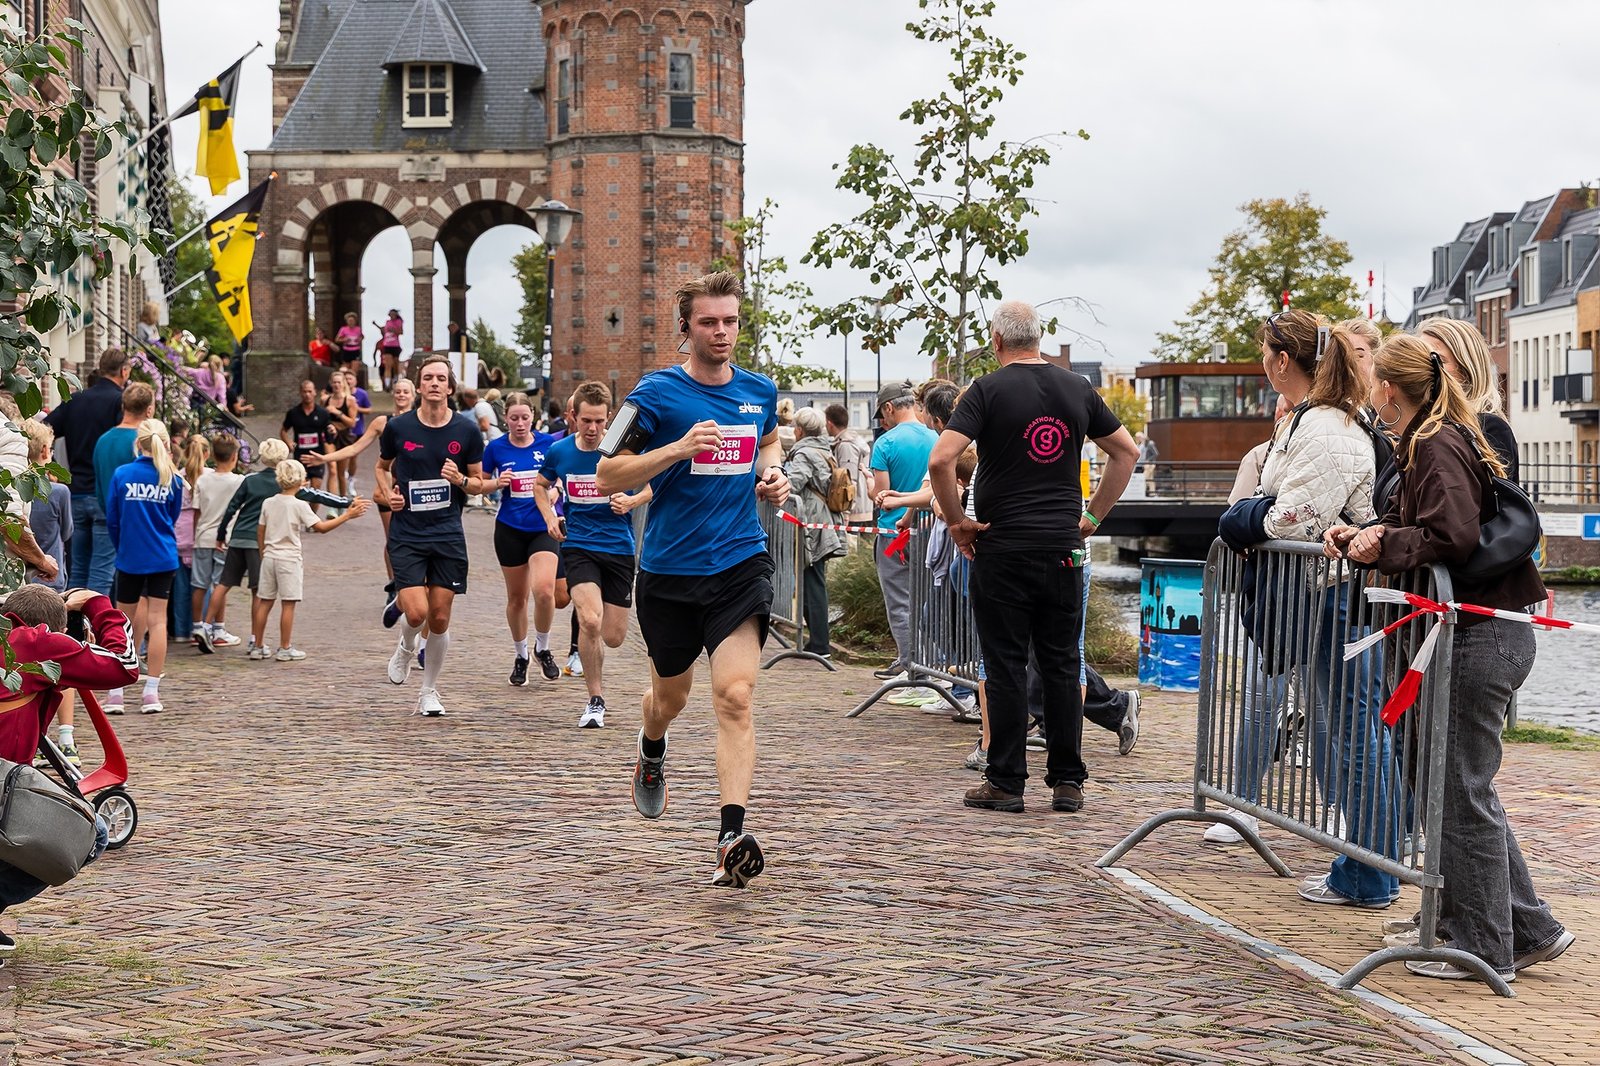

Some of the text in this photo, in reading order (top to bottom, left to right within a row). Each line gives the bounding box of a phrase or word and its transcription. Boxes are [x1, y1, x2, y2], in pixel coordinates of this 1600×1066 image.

[739, 402, 762, 413] SNEEK
[1023, 416, 1055, 439] MARATHON
[720, 440, 741, 449] OERI
[711, 450, 740, 461] 7038
[421, 494, 441, 502] 3035
